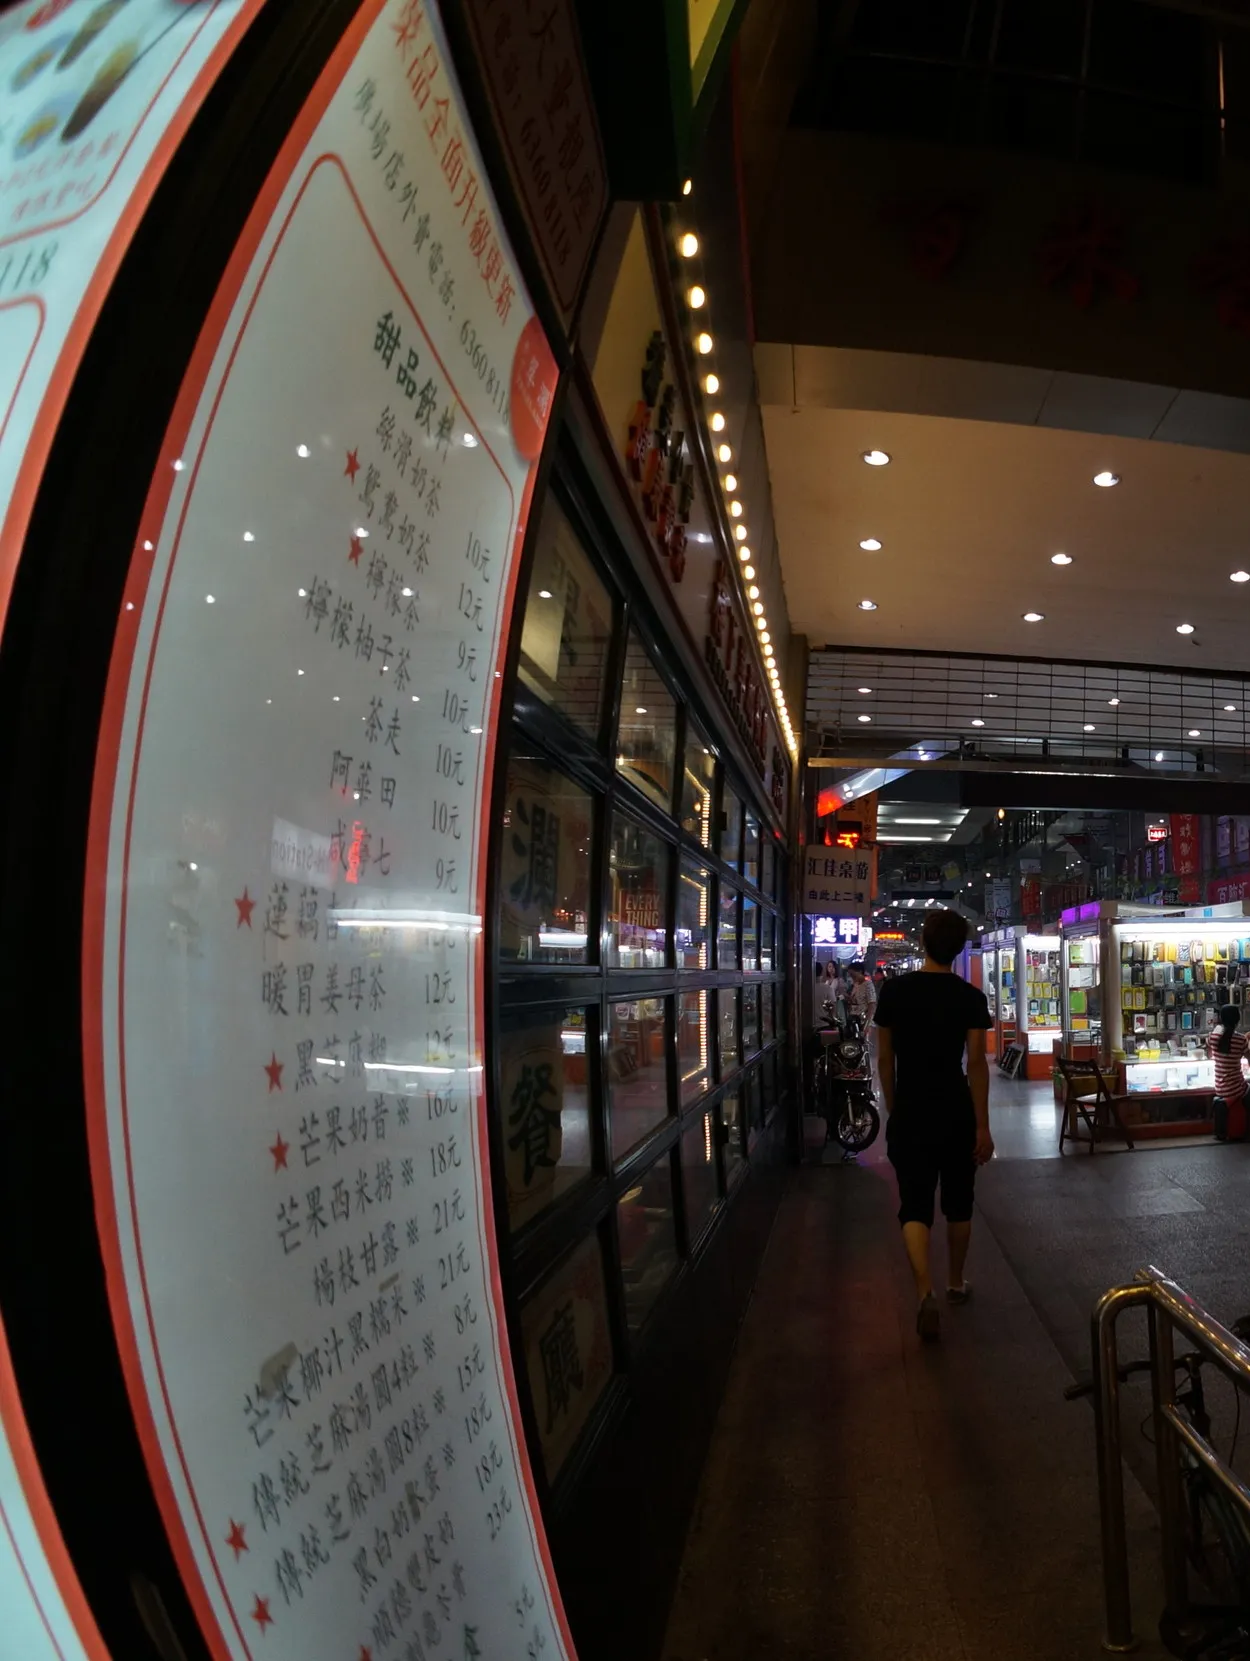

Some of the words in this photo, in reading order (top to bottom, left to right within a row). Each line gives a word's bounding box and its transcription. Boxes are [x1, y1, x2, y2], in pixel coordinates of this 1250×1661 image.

[373, 310, 456, 463] 甜品飲料
[466, 531, 491, 583] 10元
[459, 581, 483, 632] 12元
[457, 640, 476, 682] 9元
[442, 688, 469, 733] 10元
[436, 744, 464, 786] 10元
[432, 800, 461, 840] 10元
[435, 858, 458, 894] 9元
[808, 857, 869, 881] 汇佳桌游
[625, 895, 660, 911] EVERY
[626, 910, 660, 927] THING
[815, 917, 859, 943] 美甲
[425, 970, 456, 1004] 12元
[430, 1135, 462, 1178] 18元
[433, 1188, 465, 1235] 21元
[438, 1242, 470, 1290] 21元
[453, 1292, 477, 1335] 8元
[458, 1344, 485, 1393] 15元
[465, 1392, 492, 1443] 18元
